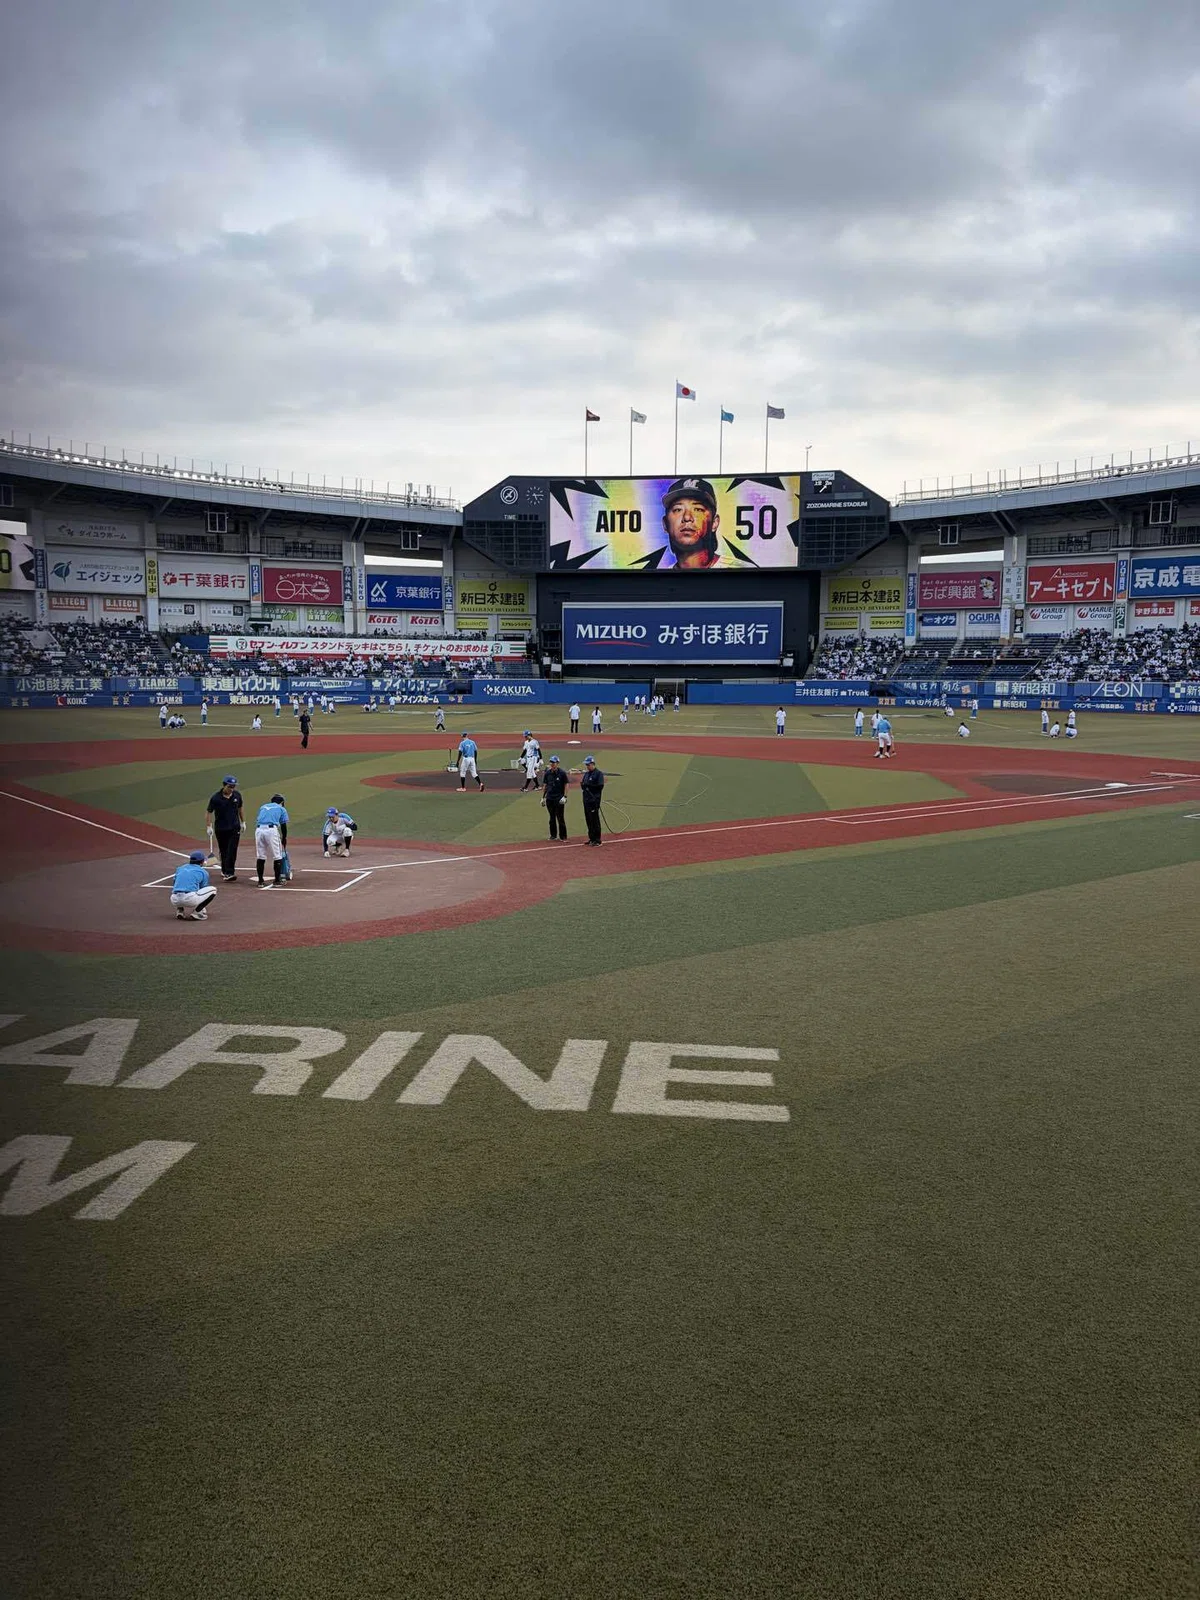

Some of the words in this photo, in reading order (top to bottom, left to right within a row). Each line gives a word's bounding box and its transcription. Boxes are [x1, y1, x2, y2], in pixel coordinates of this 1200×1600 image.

[596, 510, 641, 533] AITO
[736, 504, 778, 541] 50
[76, 570, 143, 584] エイジェック
[179, 572, 246, 588] 千葉銀行
[395, 586, 441, 600] 京葉銀行
[921, 585, 976, 600] ちば興銀
[1029, 577, 1113, 599] アーキセプト
[460, 592, 525, 606] 新日本建設
[832, 590, 901, 604] 新日本建設
[934, 615, 956, 624] オグラ
[969, 613, 1000, 622] OGURA
[576, 624, 647, 639] MIZUHO
[658, 623, 769, 645] みずほ銀行
[413, 644, 488, 654] チケットのお求めは
[16, 678, 103, 691] 小池酸素工業
[202, 677, 280, 691] 東進ハイスクール
[1011, 682, 1056, 695] 新昭和
[794, 688, 839, 697] 三井住友銀行
[67, 697, 88, 705] KOIKE
[229, 696, 279, 704] 東進ハイスクール
[1003, 700, 1027, 708] 新昭和
[0, 1015, 790, 1122] ARINE
